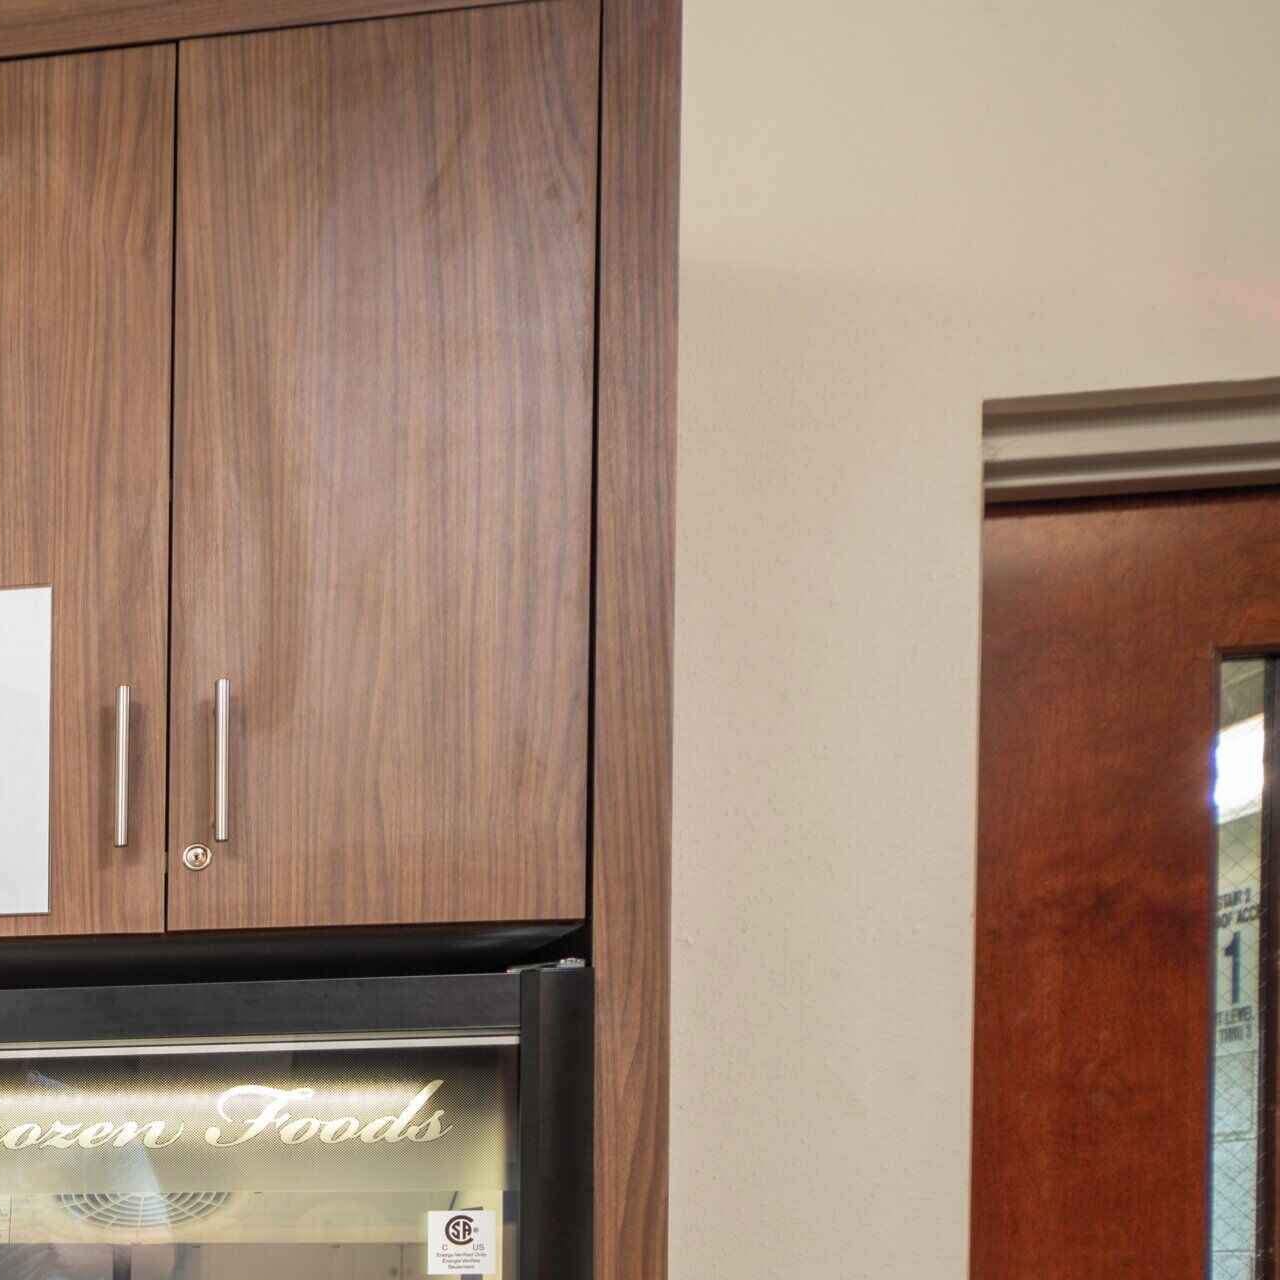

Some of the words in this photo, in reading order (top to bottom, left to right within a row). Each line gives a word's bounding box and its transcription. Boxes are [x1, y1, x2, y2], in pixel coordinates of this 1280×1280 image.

[1245, 887, 1252, 904] 2
[1224, 930, 1241, 1004] 1
[204, 1079, 453, 1149] Foods
